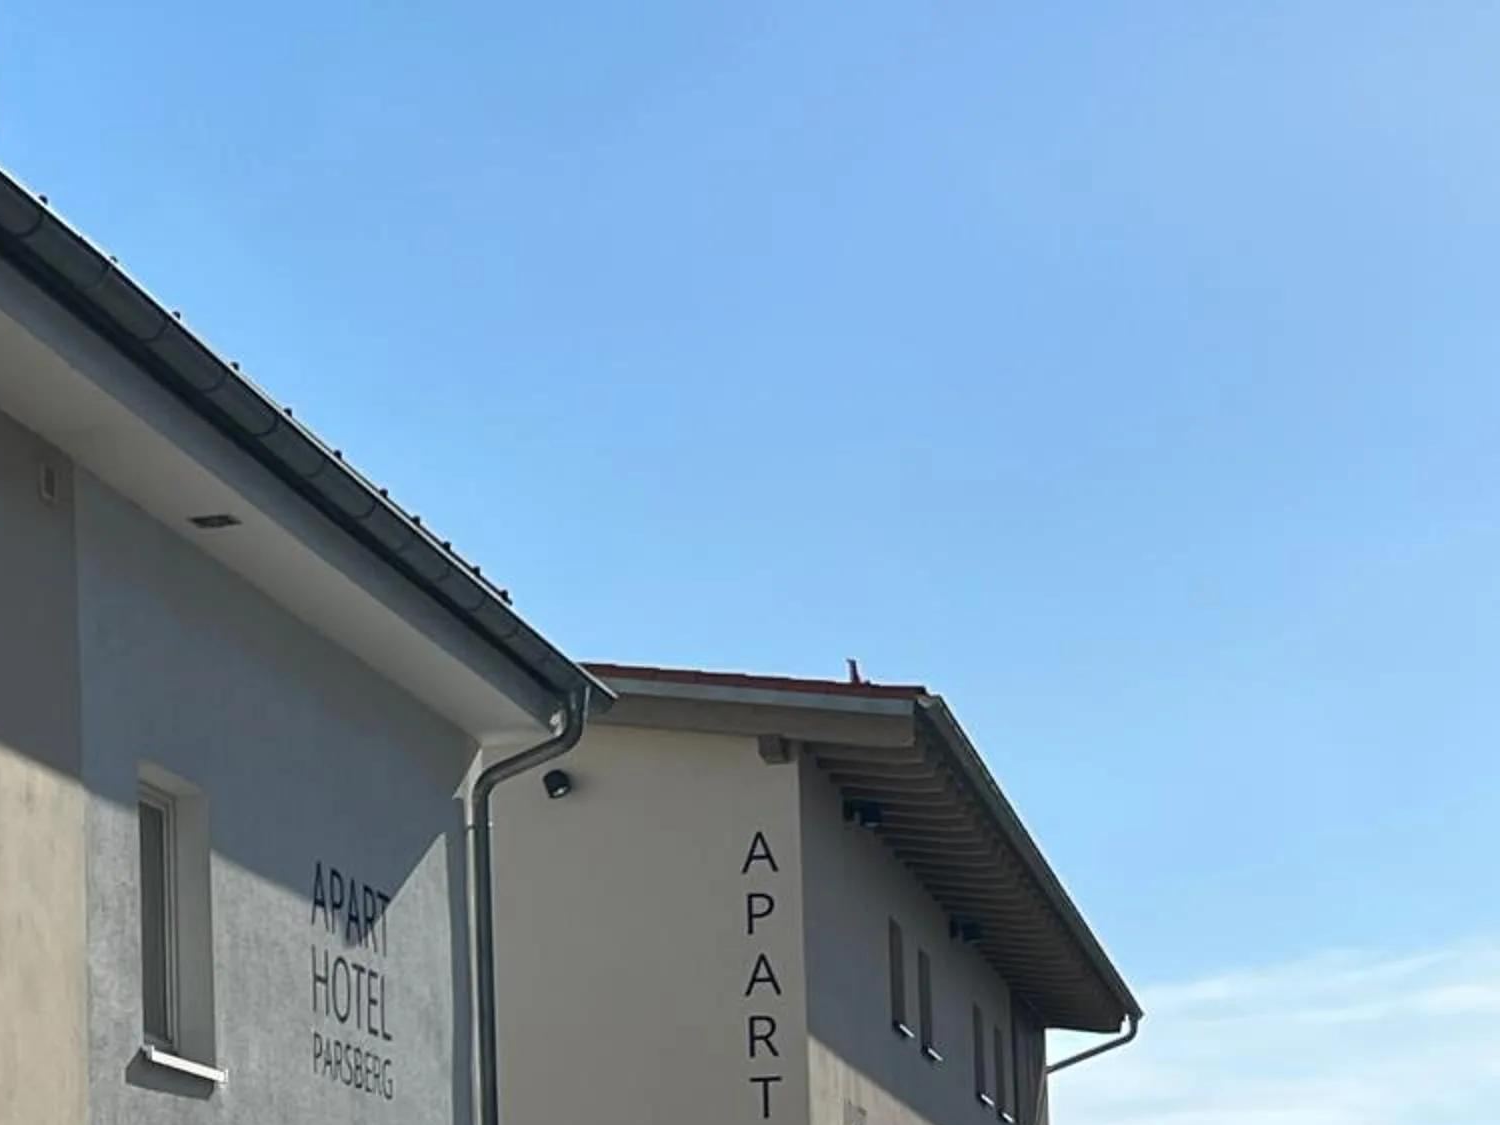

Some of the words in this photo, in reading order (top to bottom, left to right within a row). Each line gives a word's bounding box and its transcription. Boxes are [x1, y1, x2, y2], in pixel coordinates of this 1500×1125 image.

[311, 861, 391, 957] APART
[311, 944, 392, 1042] HOTEL
[313, 1031, 393, 1101] PARSBERG
